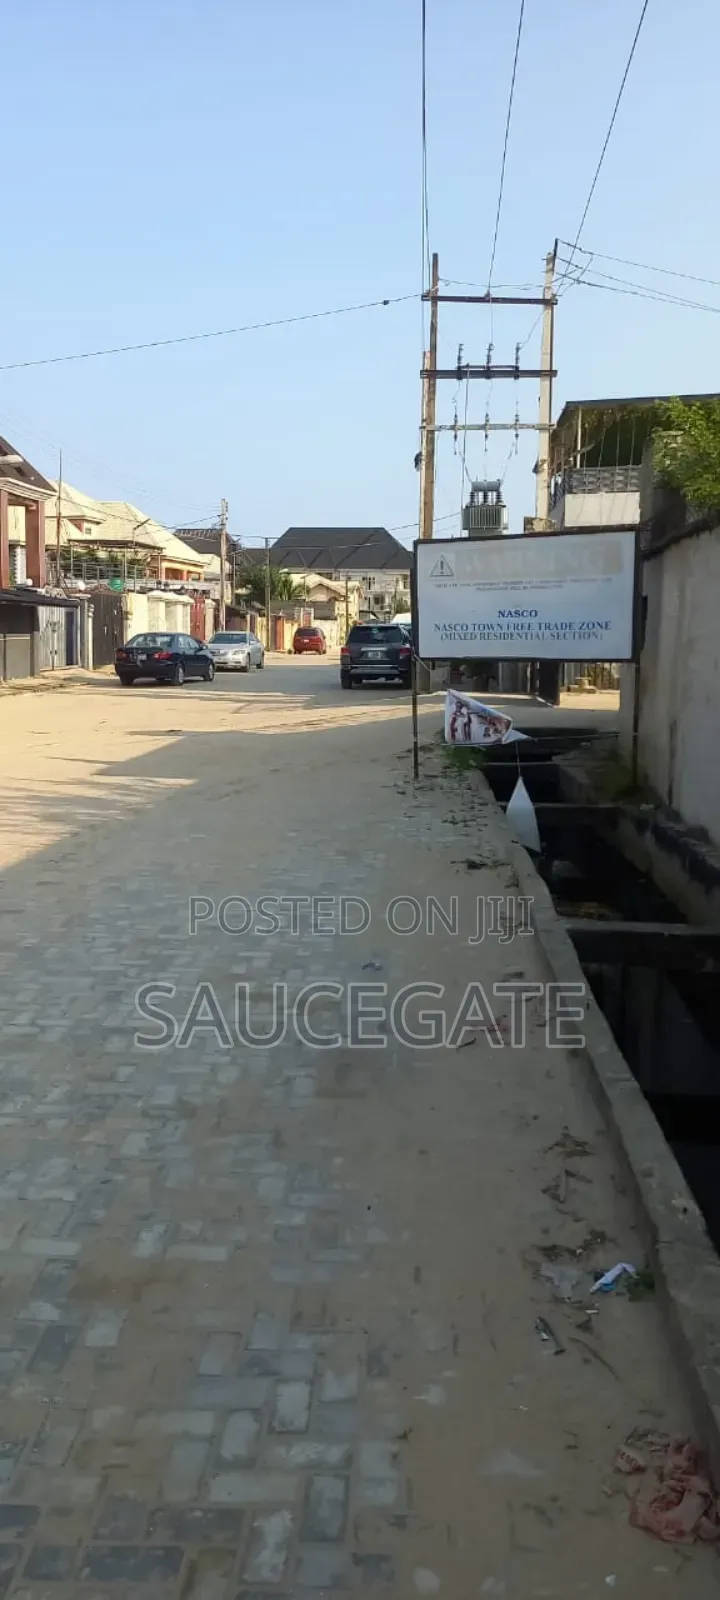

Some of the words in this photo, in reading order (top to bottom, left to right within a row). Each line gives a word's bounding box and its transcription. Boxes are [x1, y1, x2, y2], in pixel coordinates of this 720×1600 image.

[498, 609, 538, 618] NASCO
[434, 623, 469, 632] NASCO
[472, 623, 503, 632] TOWN
[506, 622, 532, 631] FREE
[538, 622, 575, 631] TRADE
[579, 621, 612, 631] ZONE
[440, 632, 477, 641] (MIXED
[480, 631, 545, 641] RESIDENTIAL
[550, 631, 604, 641] SECTION)
